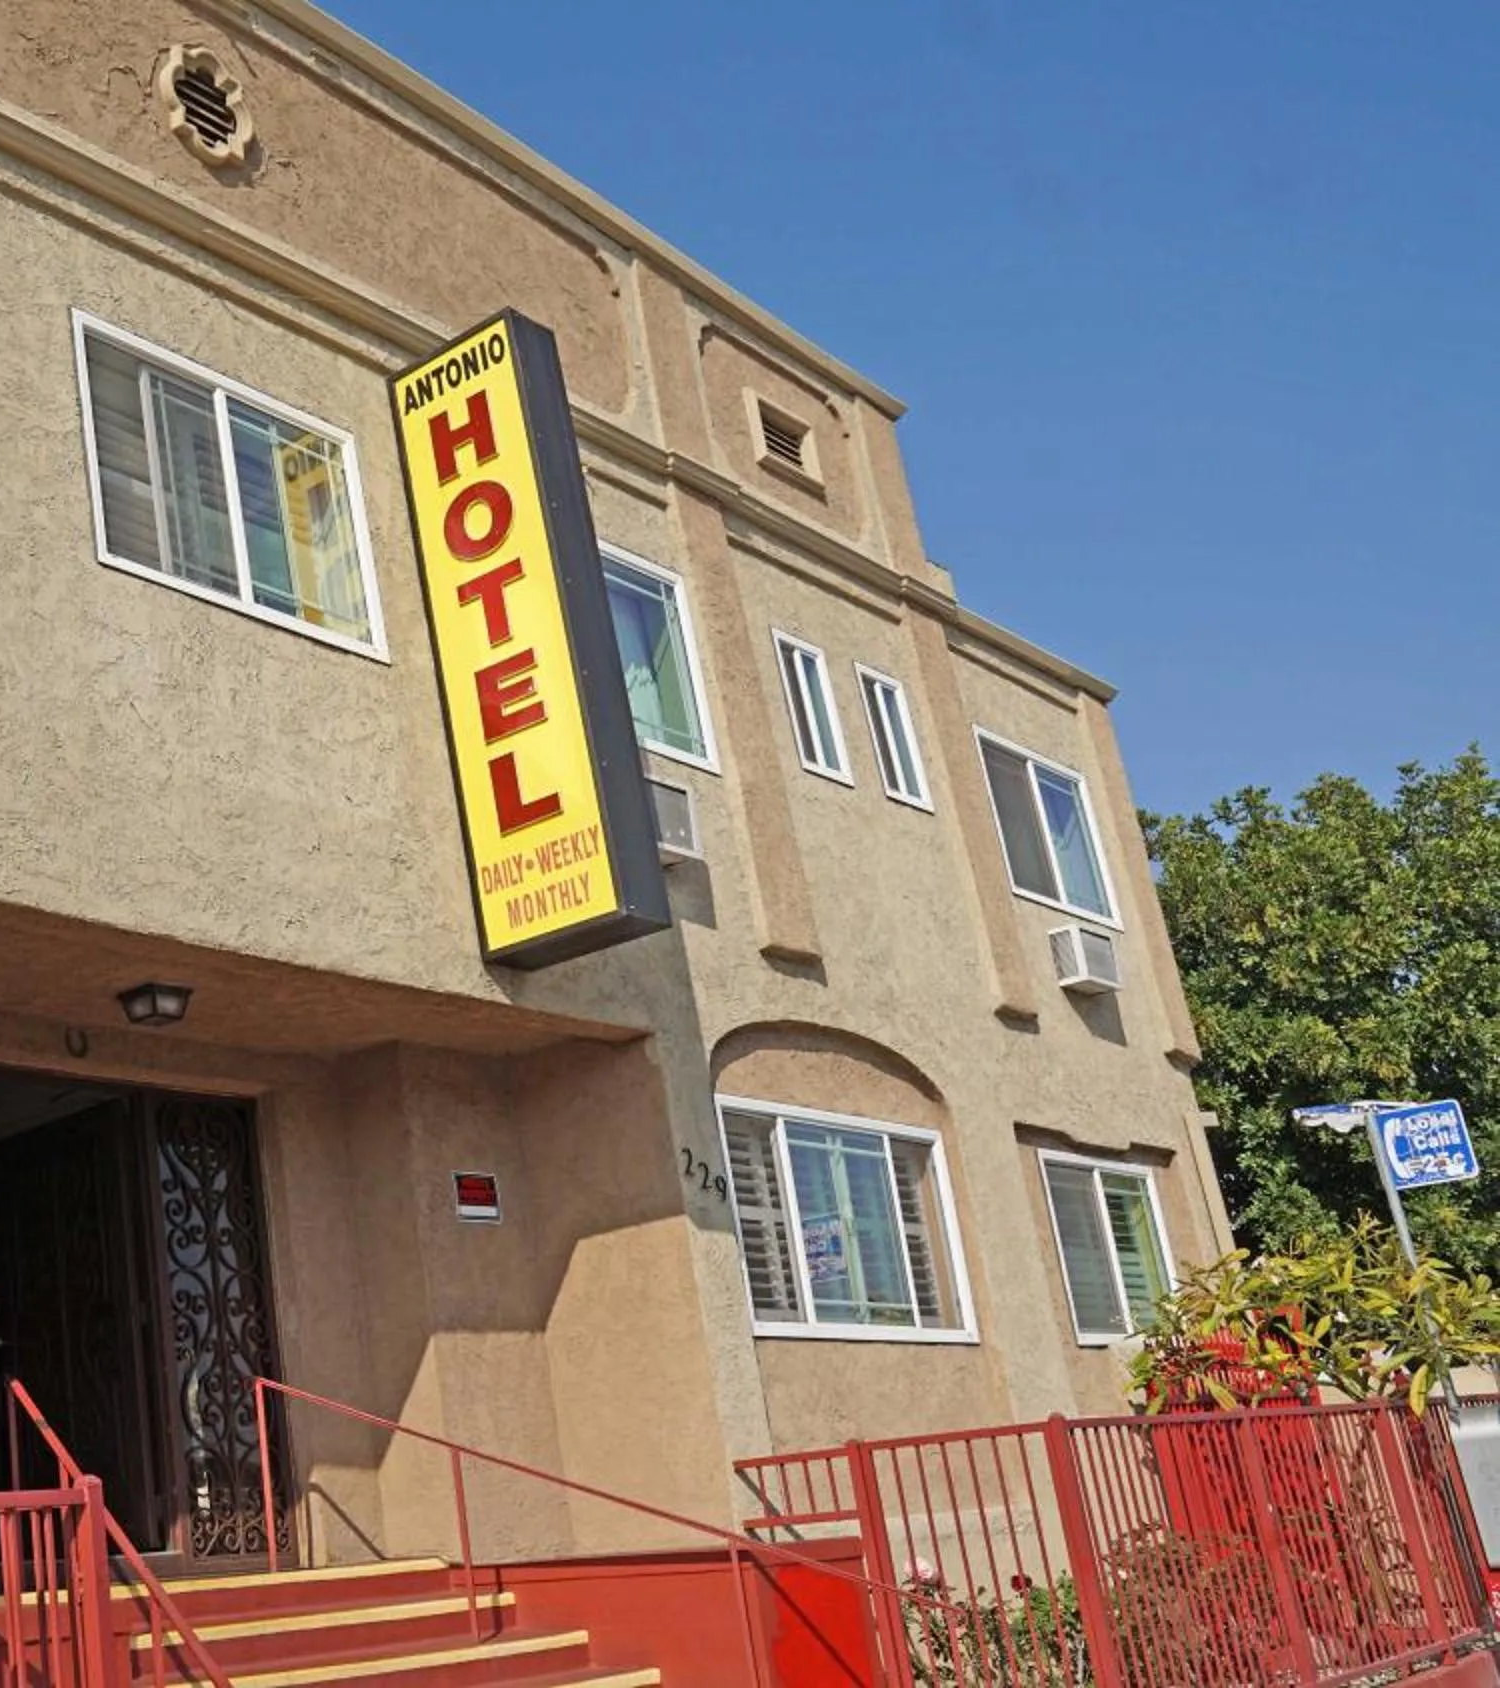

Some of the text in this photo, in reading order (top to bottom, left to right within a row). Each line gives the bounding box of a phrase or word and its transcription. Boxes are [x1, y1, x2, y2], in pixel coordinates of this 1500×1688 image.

[403, 333, 506, 416] ANTONIO
[428, 388, 564, 838] HOTEL
[506, 871, 592, 929] MONTHLY
[681, 1147, 727, 1202] 229
